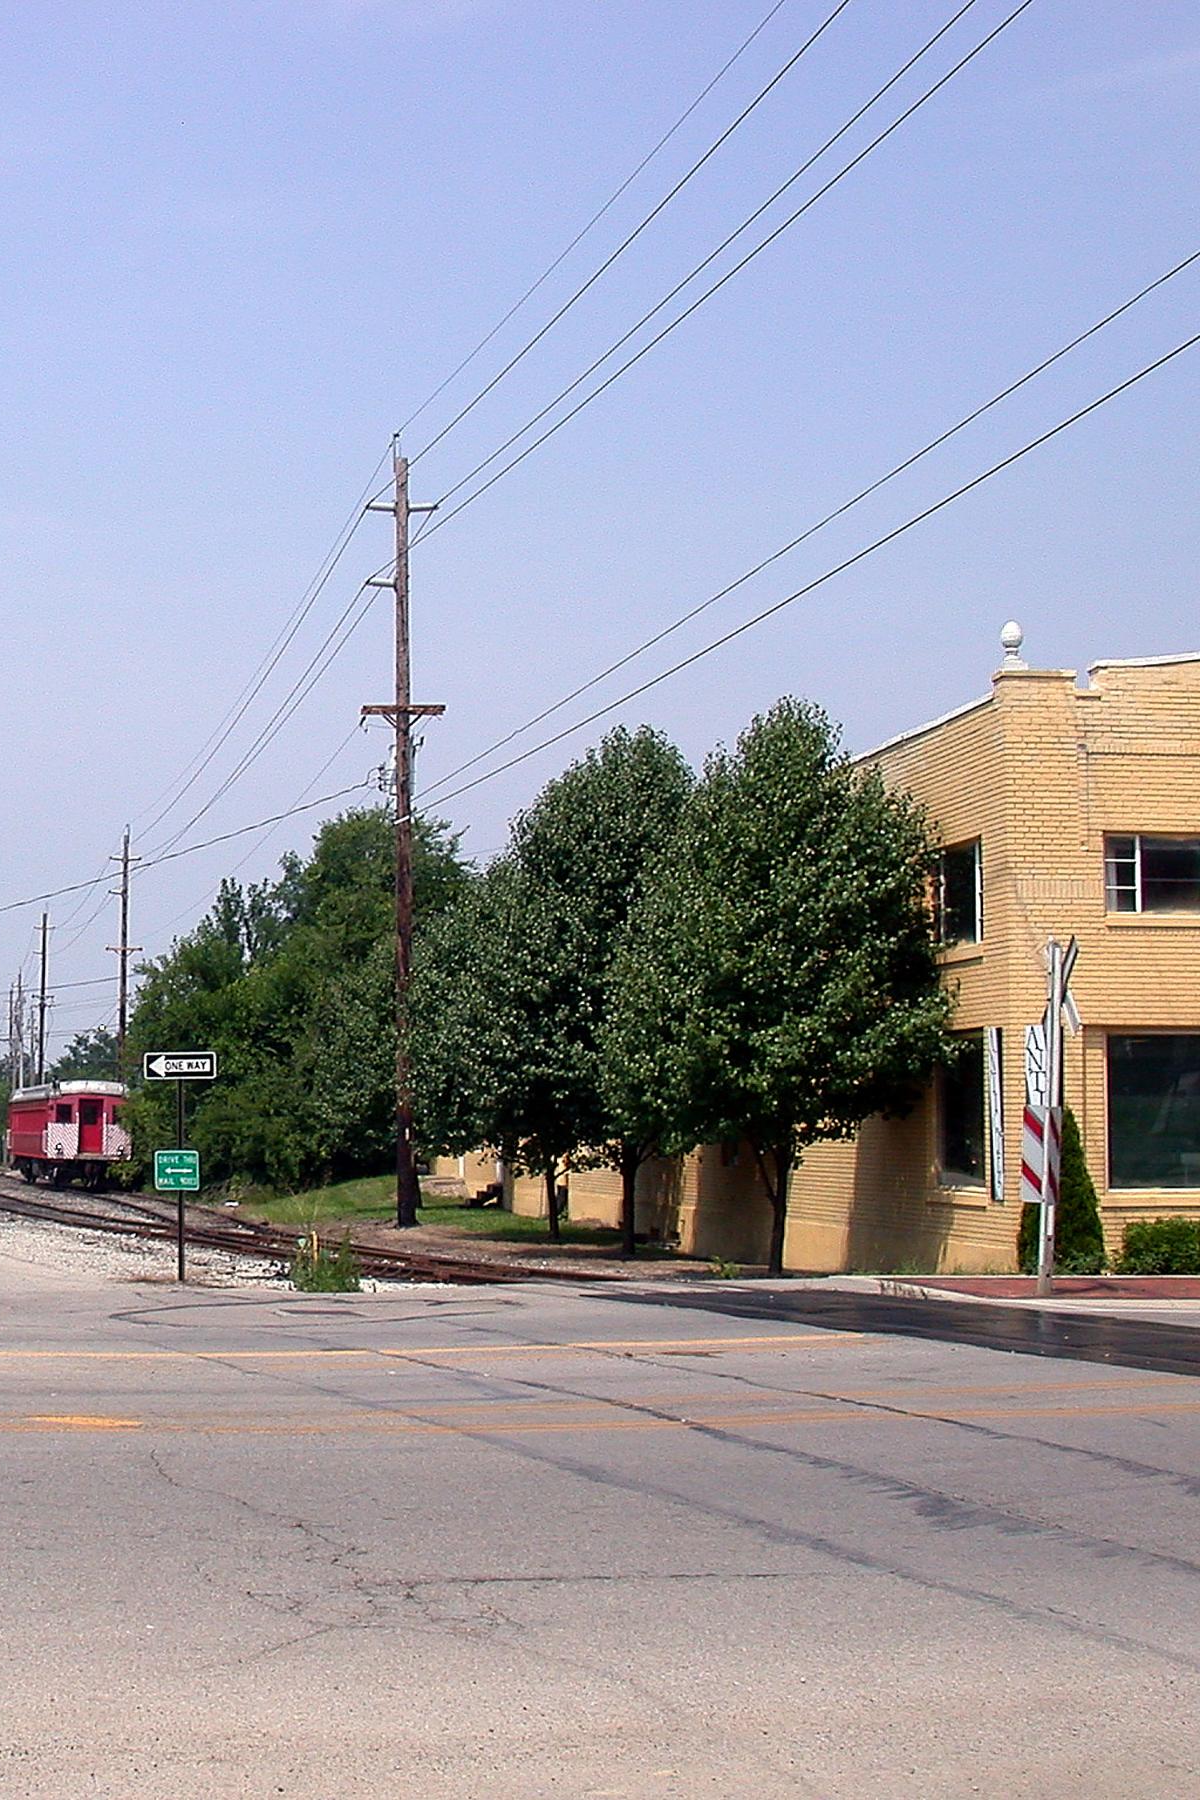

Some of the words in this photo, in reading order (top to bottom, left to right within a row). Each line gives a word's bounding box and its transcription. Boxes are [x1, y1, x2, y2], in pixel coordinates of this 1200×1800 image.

[165, 1061, 184, 1071] ONE
[186, 1061, 207, 1070] WAY
[158, 1155, 179, 1164] DRIVE
[159, 1177, 175, 1185] MAIL
